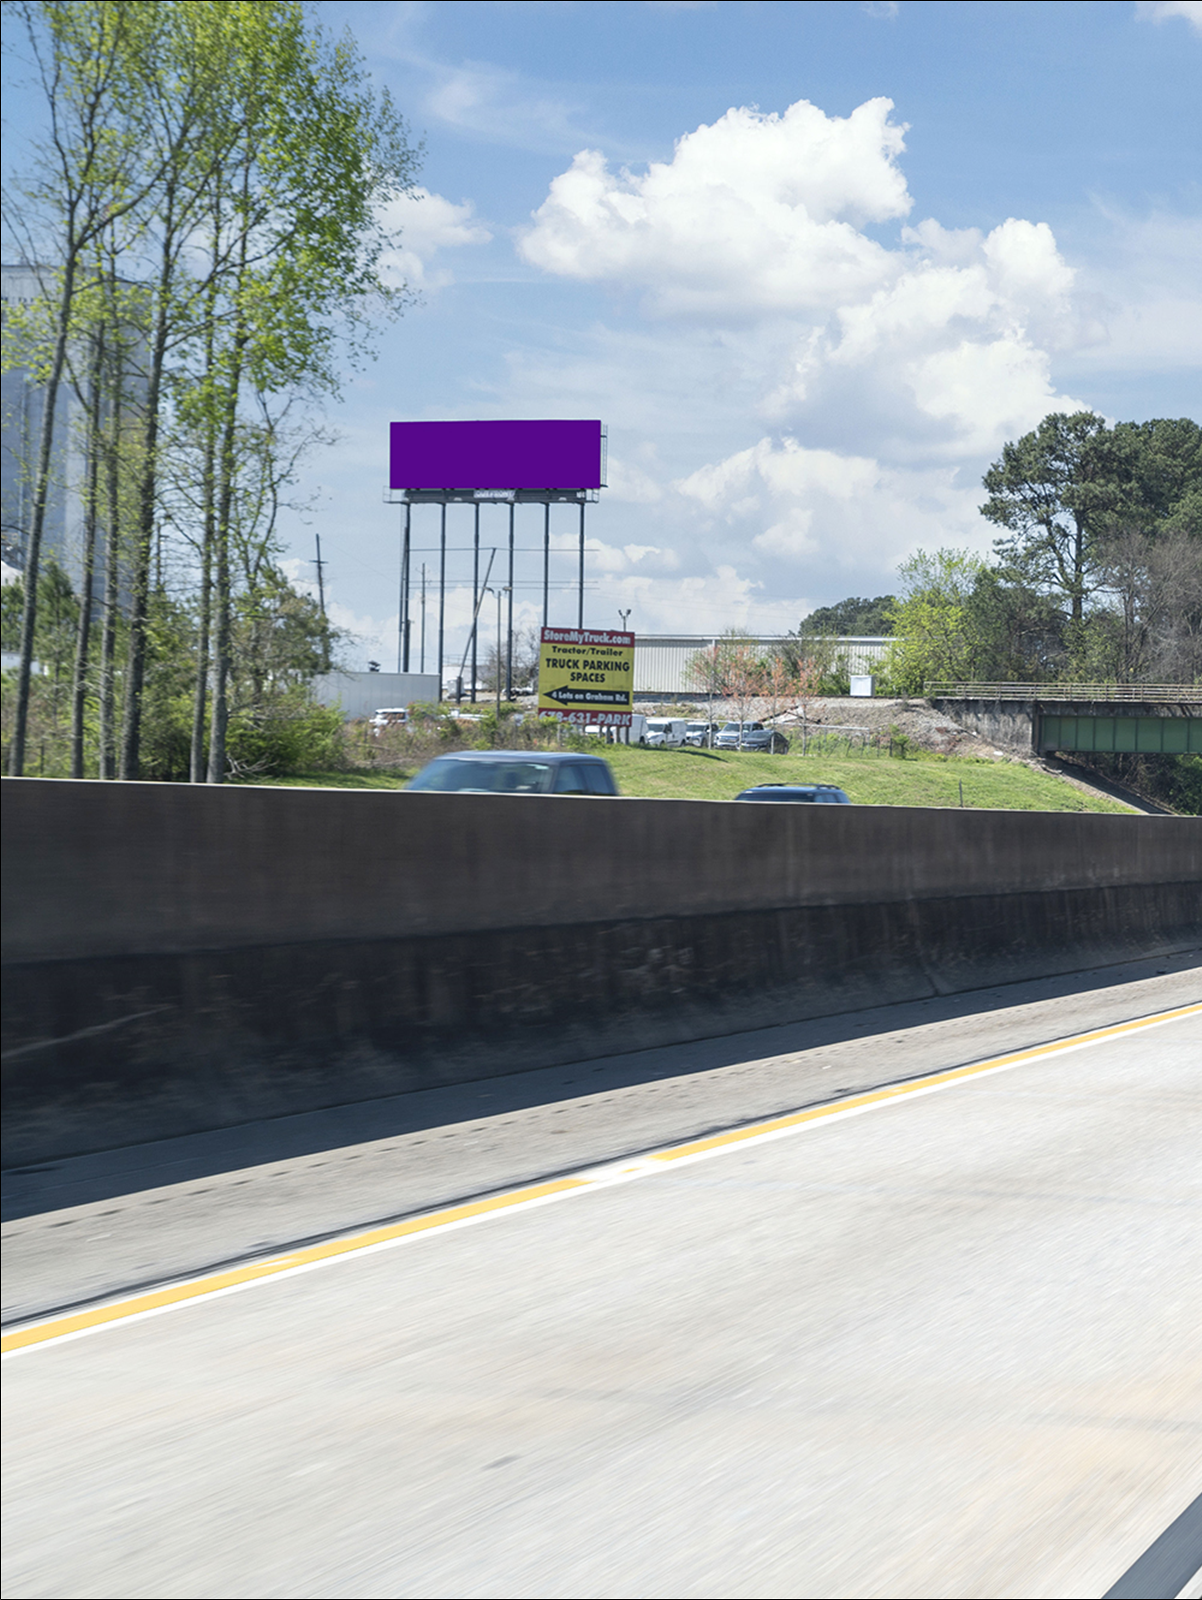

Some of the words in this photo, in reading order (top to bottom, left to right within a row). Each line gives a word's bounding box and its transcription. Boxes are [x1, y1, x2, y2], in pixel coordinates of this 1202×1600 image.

[544, 629, 631, 645] StoreMyTruck.com
[552, 646, 623, 656] Tractor/Trailer
[545, 658, 580, 669] TRUCK
[582, 660, 630, 672] PARKING
[570, 672, 606, 683] SPACES
[551, 691, 557, 699] 4
[558, 691, 573, 699] Lots
[585, 692, 614, 701] Graham
[615, 694, 628, 702] Rd.
